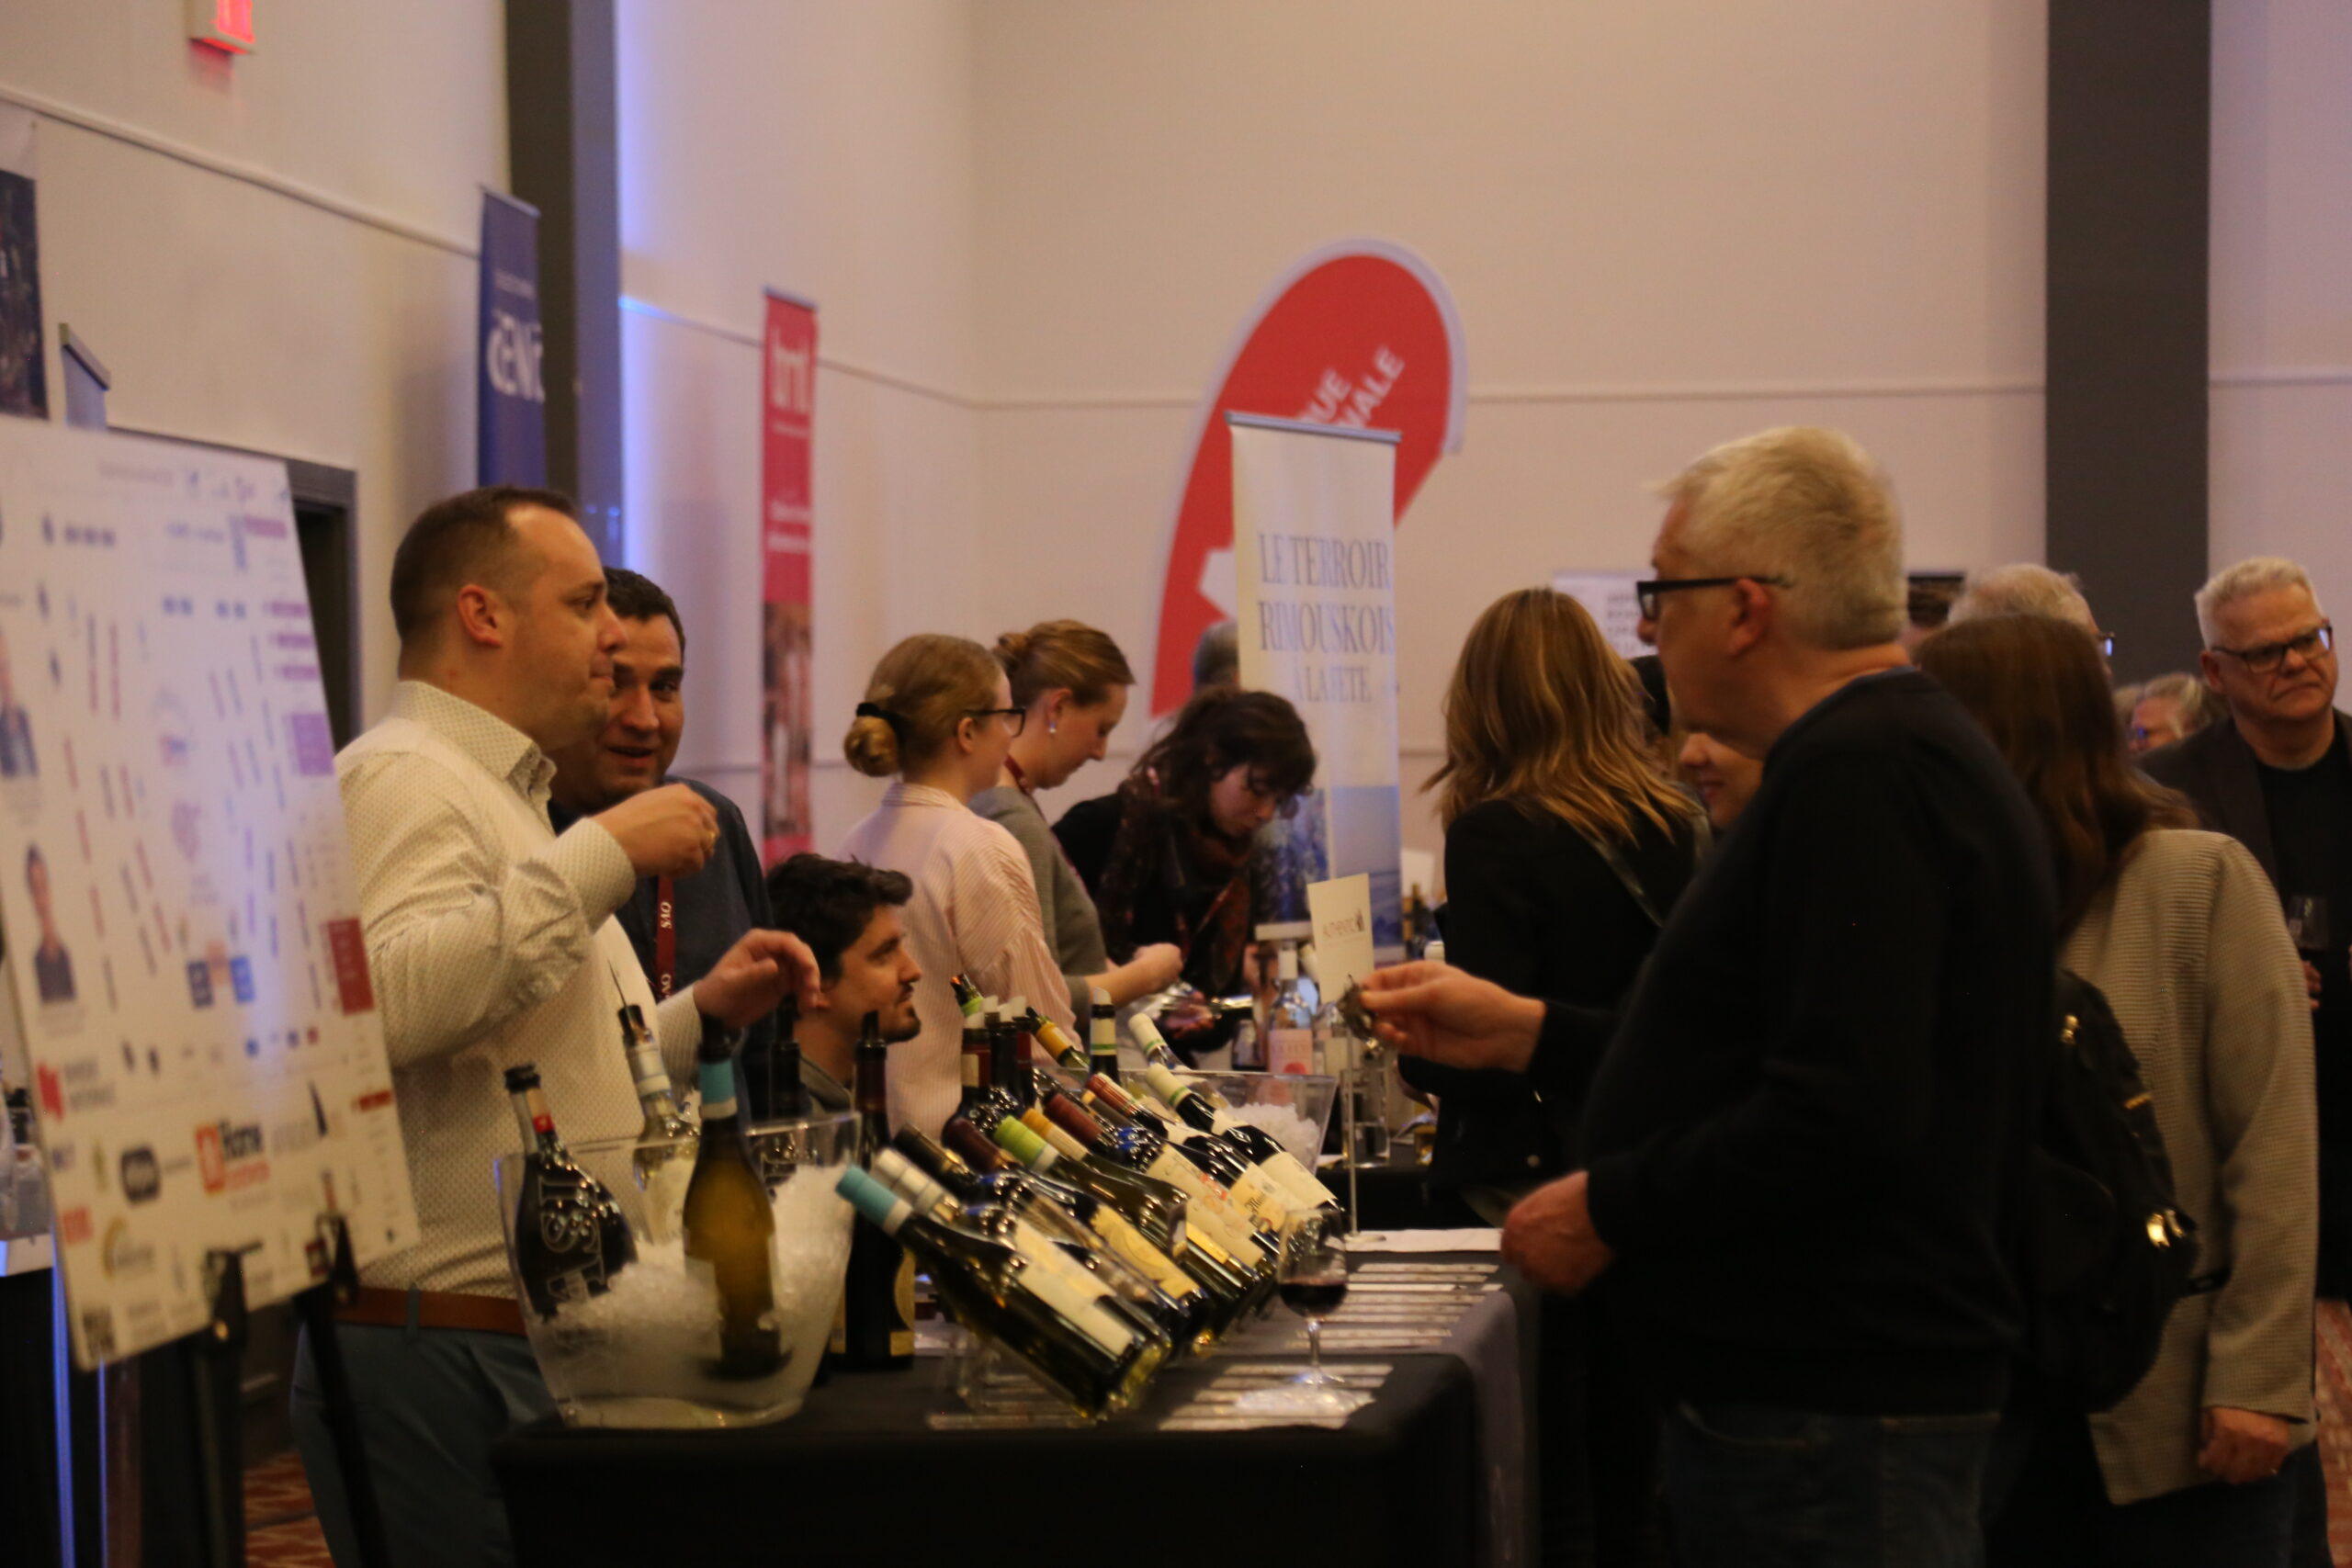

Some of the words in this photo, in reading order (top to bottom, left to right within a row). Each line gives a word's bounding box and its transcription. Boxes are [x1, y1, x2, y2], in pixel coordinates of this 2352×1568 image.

[1259, 533, 1286, 584] LE
[1288, 535, 1391, 590] TERROIR
[1258, 601, 1394, 655] RIMOUSKOIS
